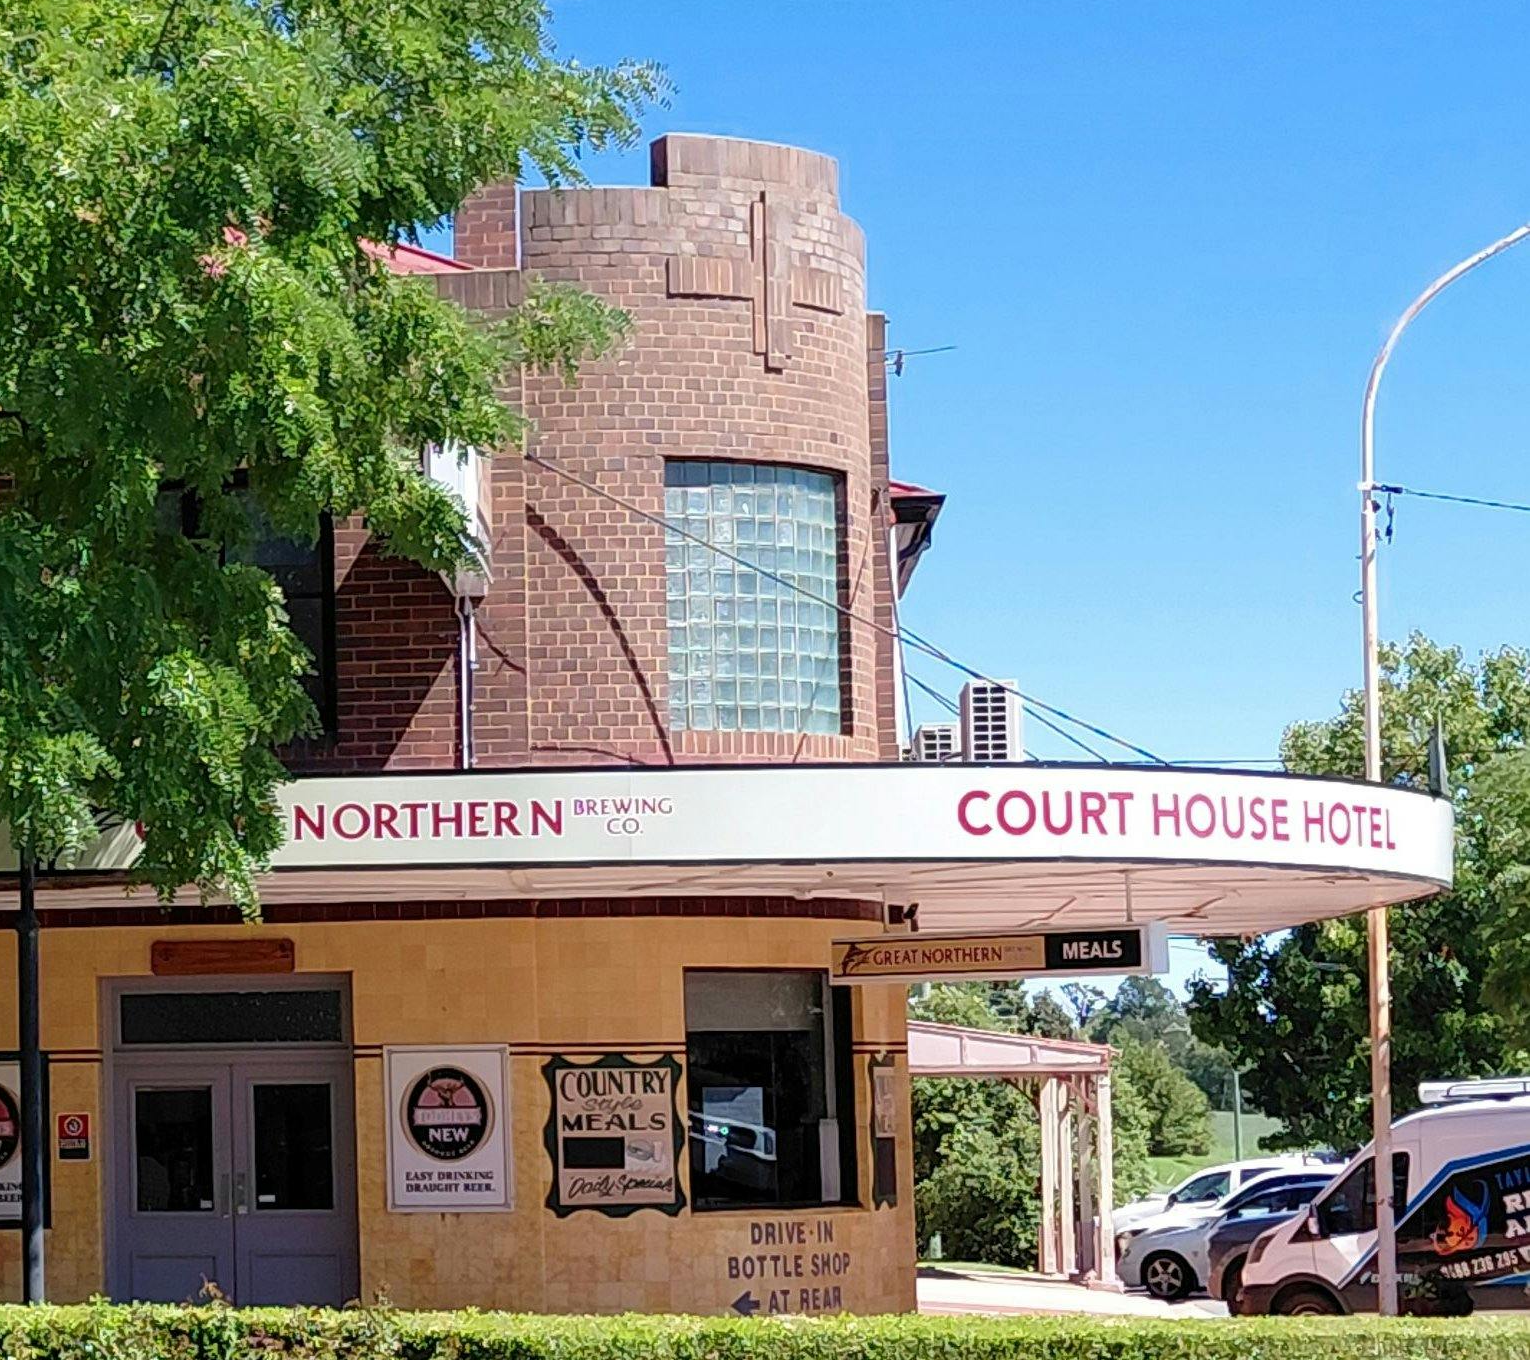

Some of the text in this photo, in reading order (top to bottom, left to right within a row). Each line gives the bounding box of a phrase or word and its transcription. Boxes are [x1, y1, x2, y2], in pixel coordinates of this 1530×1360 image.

[573, 797, 673, 816] BREWING
[293, 800, 563, 840] NORTHERN
[606, 817, 644, 835] CO.
[957, 790, 1396, 850] COURT HOUSE HOTEL
[873, 946, 917, 966] GREAT
[921, 945, 1003, 965] NORTHERN
[1062, 940, 1123, 960] MEALS
[560, 1070, 669, 1102] COUNTRY
[561, 1112, 667, 1132] MEALS
[428, 1127, 470, 1143] NEW
[405, 1171, 494, 1181] EASY DRINKING
[405, 1183, 460, 1193] DRAUGHT
[727, 1251, 851, 1279] BOTTLE SHOP
[768, 1285, 843, 1313] AT REAR
